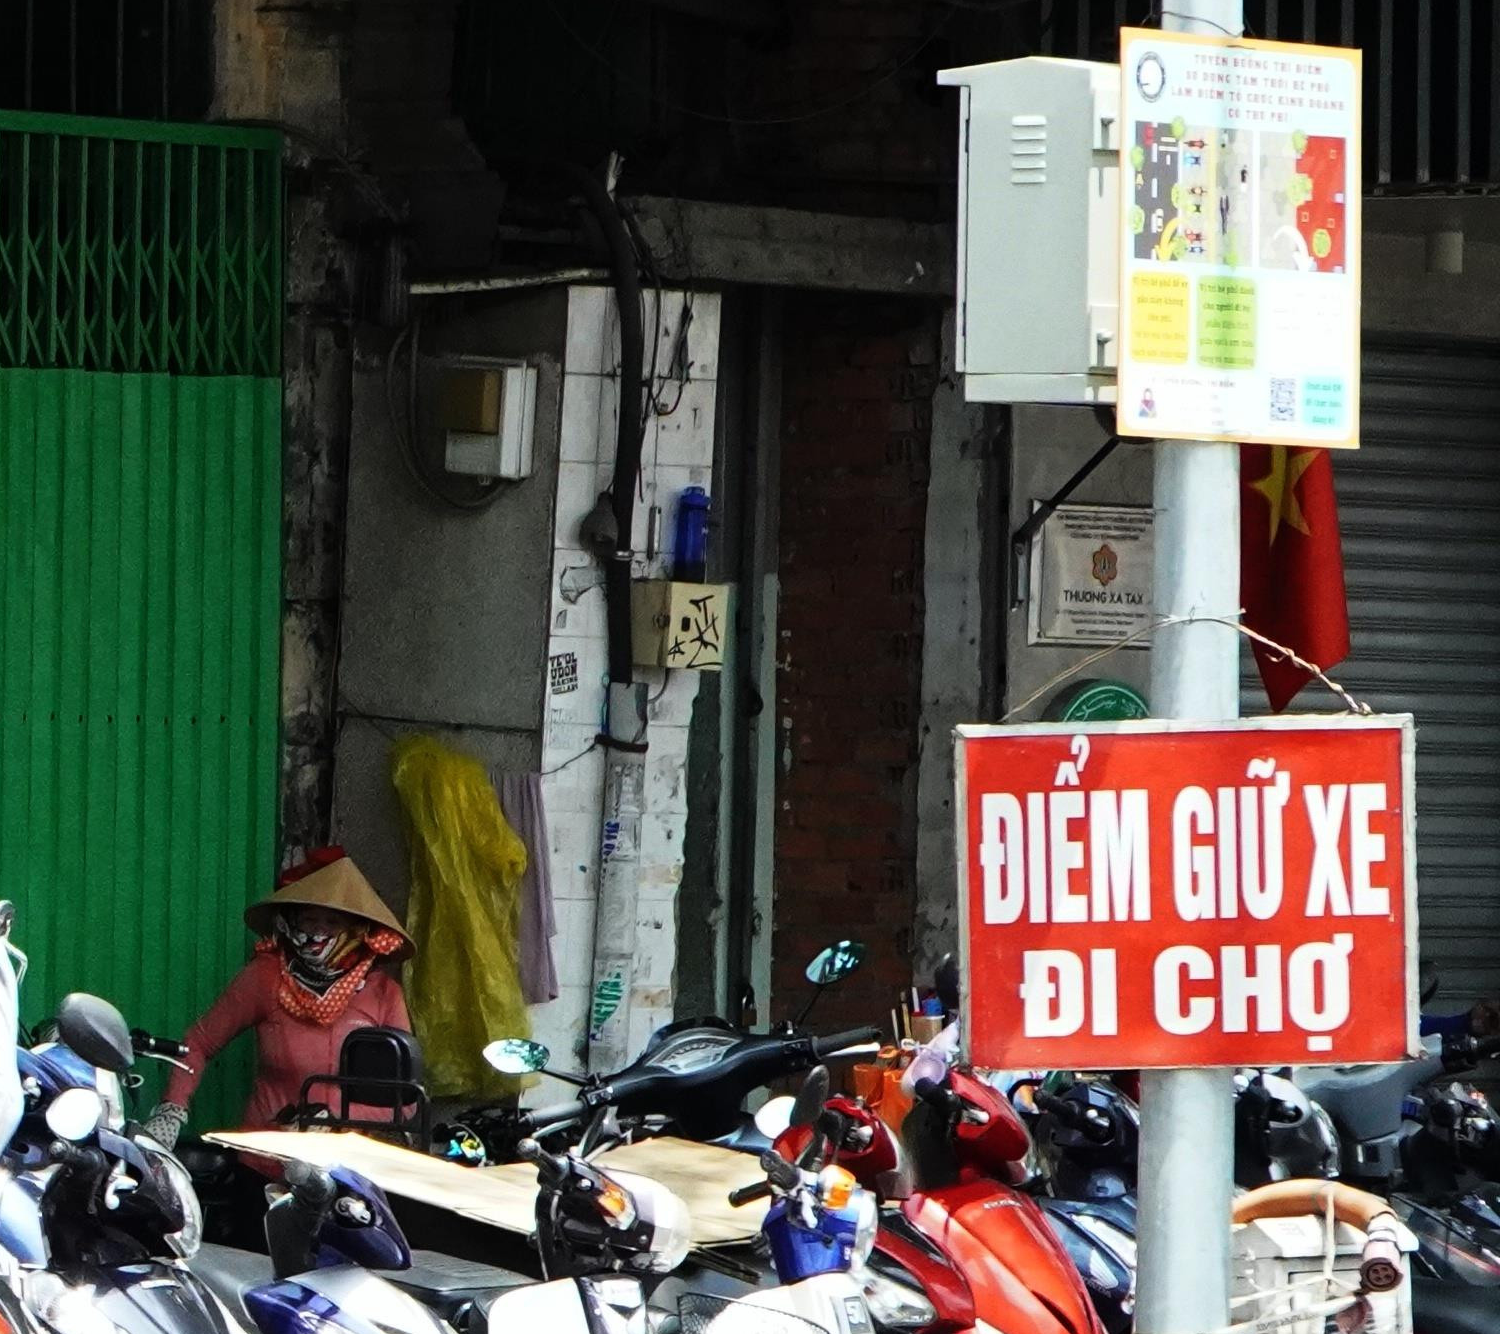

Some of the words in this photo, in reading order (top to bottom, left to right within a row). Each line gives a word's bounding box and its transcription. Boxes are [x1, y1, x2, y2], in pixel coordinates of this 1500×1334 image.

[551, 663, 577, 680] UDON
[979, 734, 1152, 925] ĐIỂM
[1171, 757, 1291, 922] GIỮ
[1303, 782, 1391, 917] XE
[1019, 948, 1118, 1038] ĐI
[1153, 933, 1354, 1052] CHỢ
